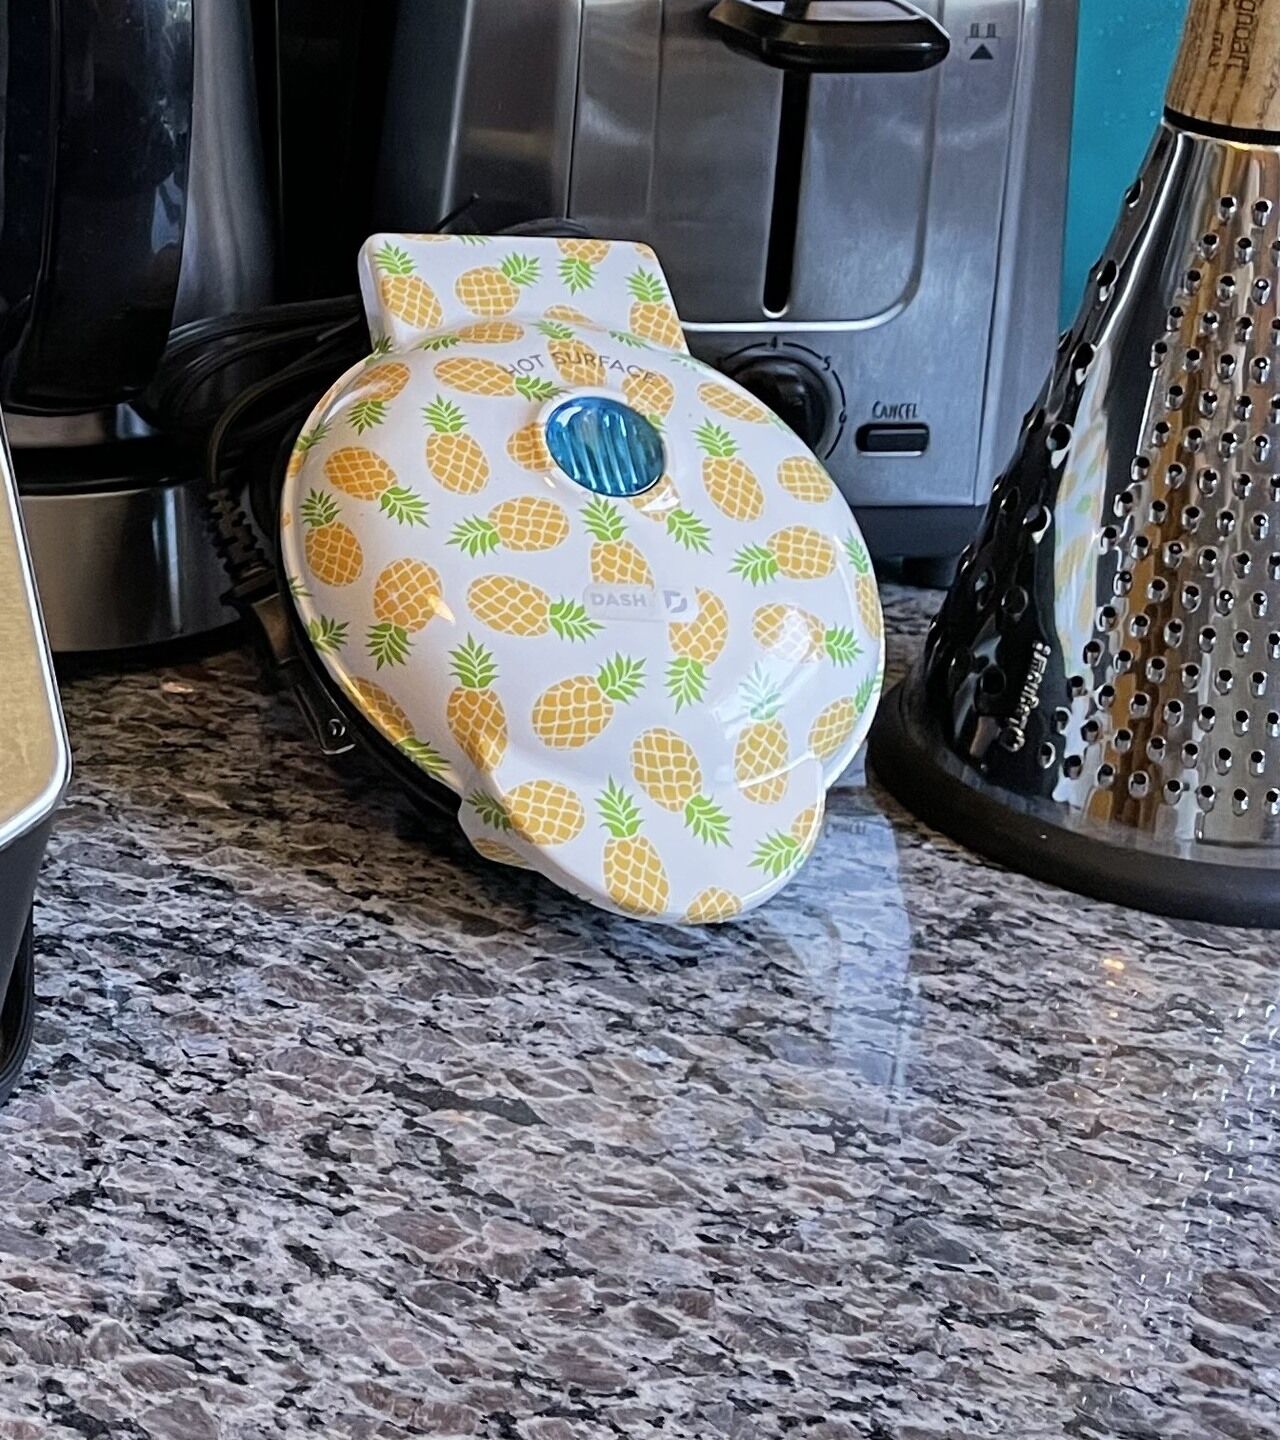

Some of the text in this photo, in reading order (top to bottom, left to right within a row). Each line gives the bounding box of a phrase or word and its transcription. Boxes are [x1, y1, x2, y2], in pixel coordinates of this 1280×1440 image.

[502, 350, 659, 387] HOT SURFACE
[589, 591, 648, 608] DASH
